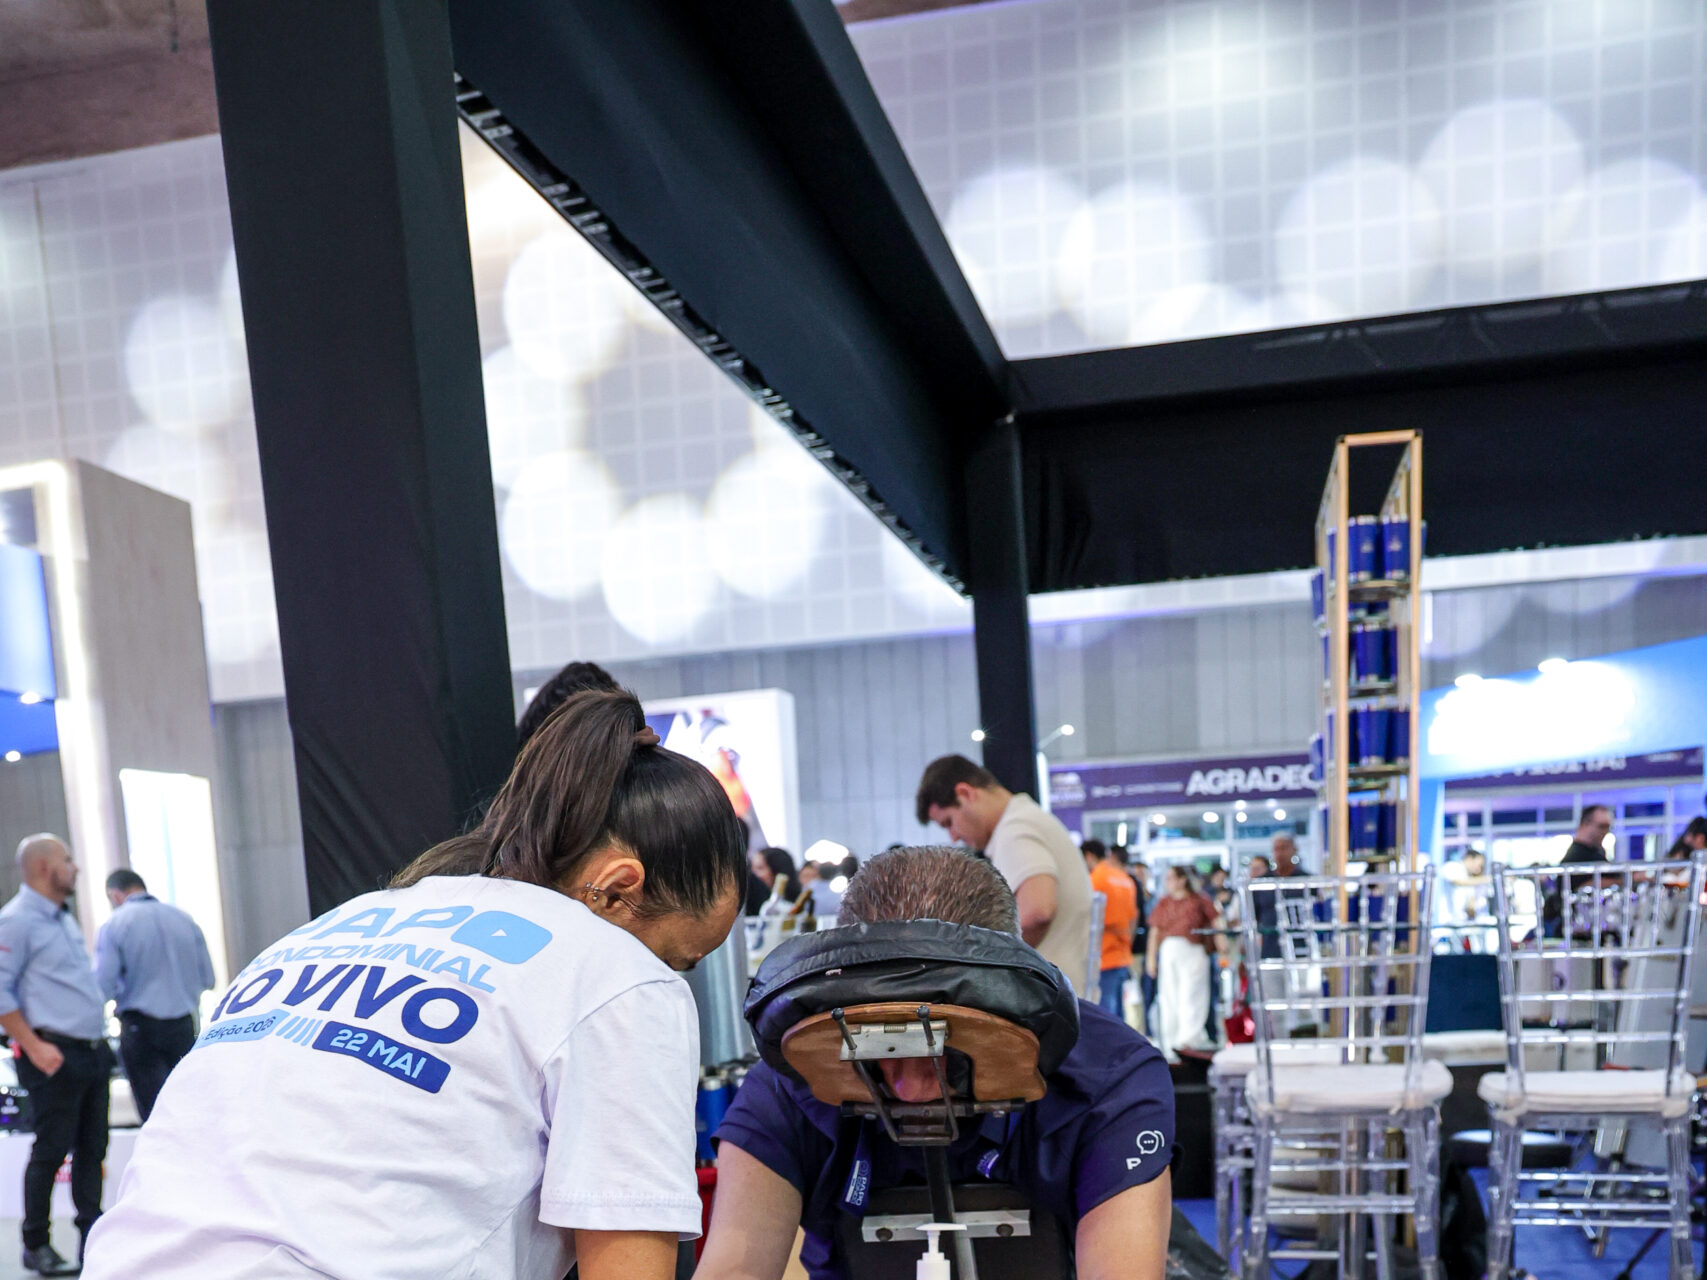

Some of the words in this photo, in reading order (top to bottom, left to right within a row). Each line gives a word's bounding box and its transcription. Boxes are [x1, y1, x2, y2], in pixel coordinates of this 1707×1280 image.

[281, 964, 479, 1044] VIVO
[330, 1028, 369, 1052] 22
[367, 1038, 427, 1079] MAI
